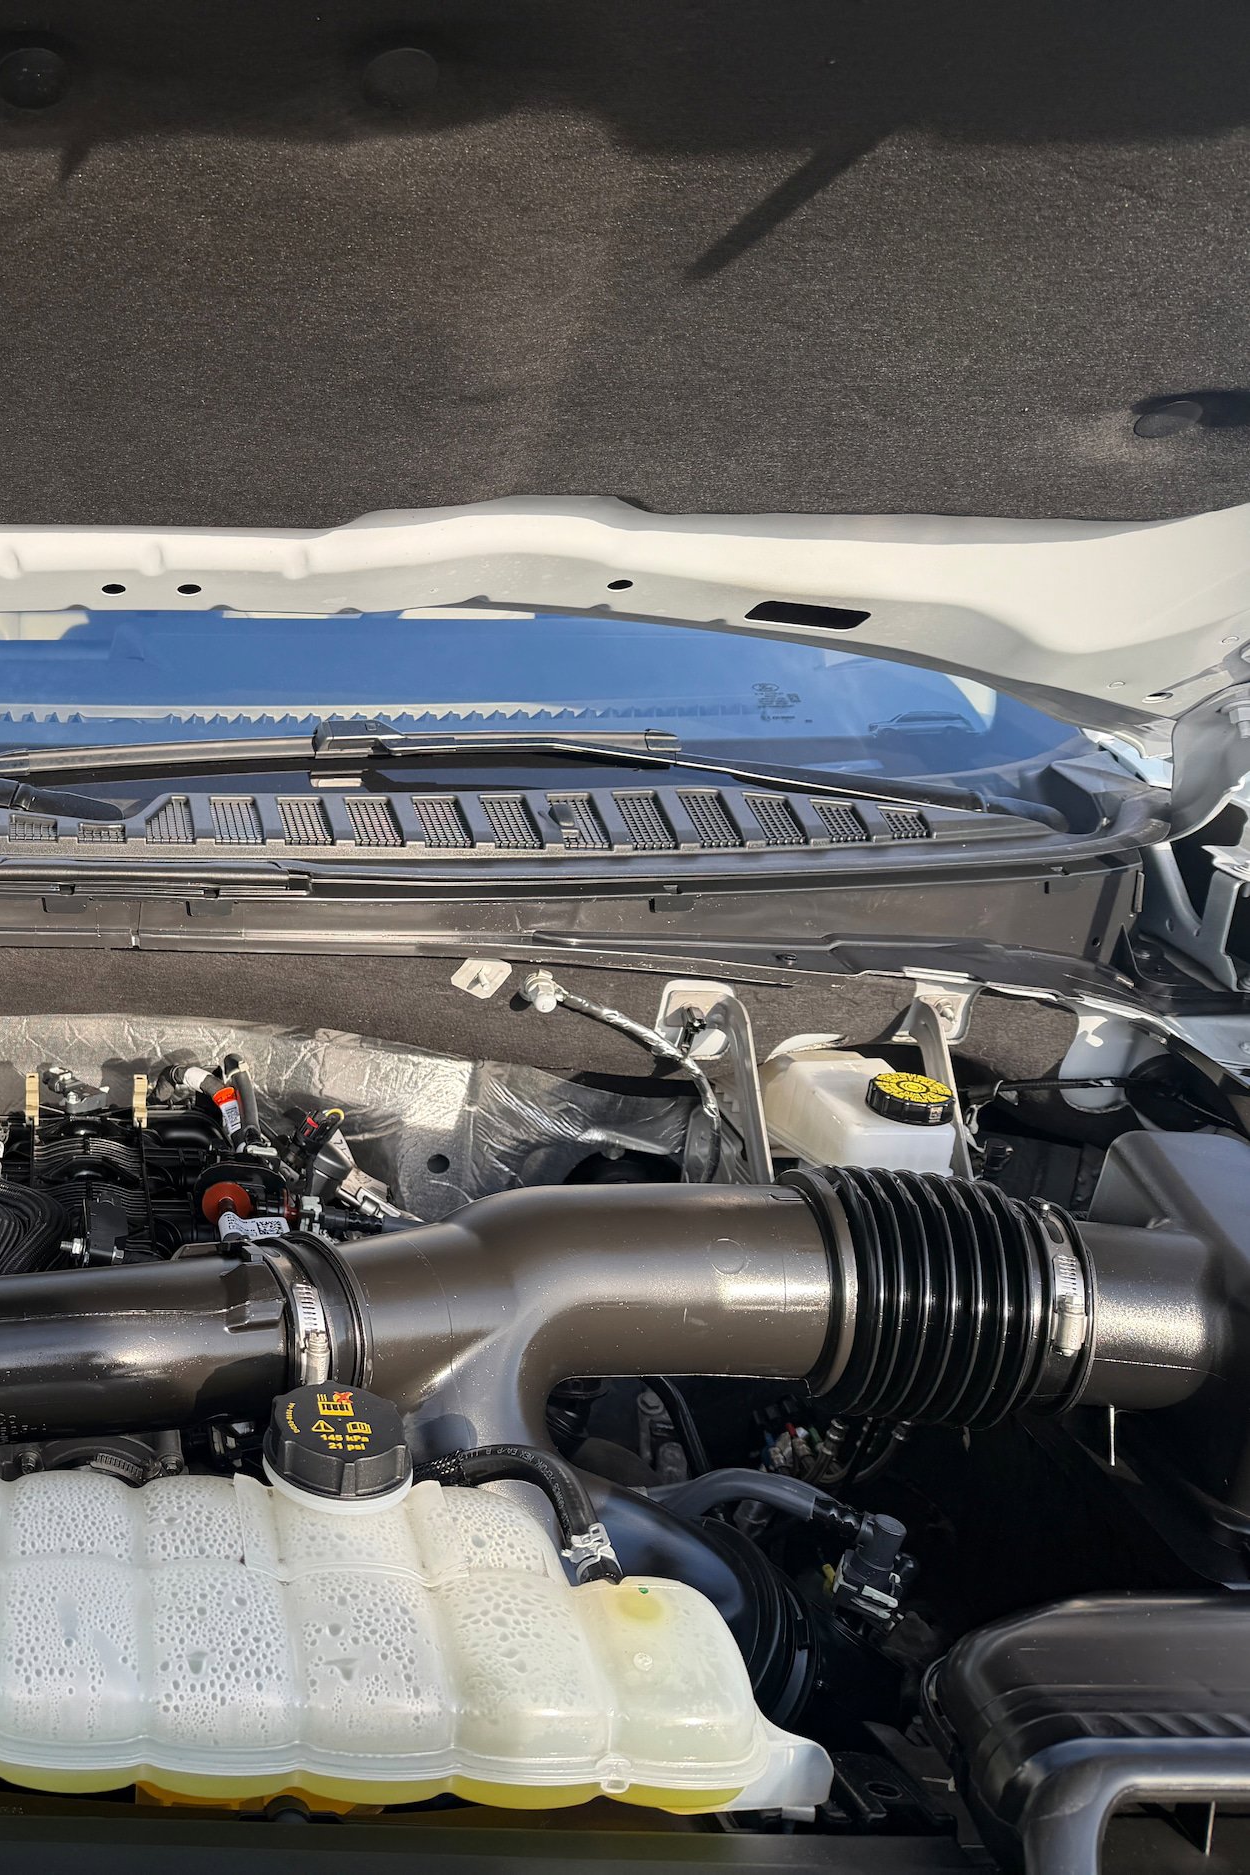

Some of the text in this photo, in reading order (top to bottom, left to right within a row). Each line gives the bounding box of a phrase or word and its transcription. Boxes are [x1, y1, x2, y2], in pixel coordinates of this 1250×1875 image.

[346, 1435, 370, 1443] kPa
[328, 1442, 366, 1452] 21 psi
